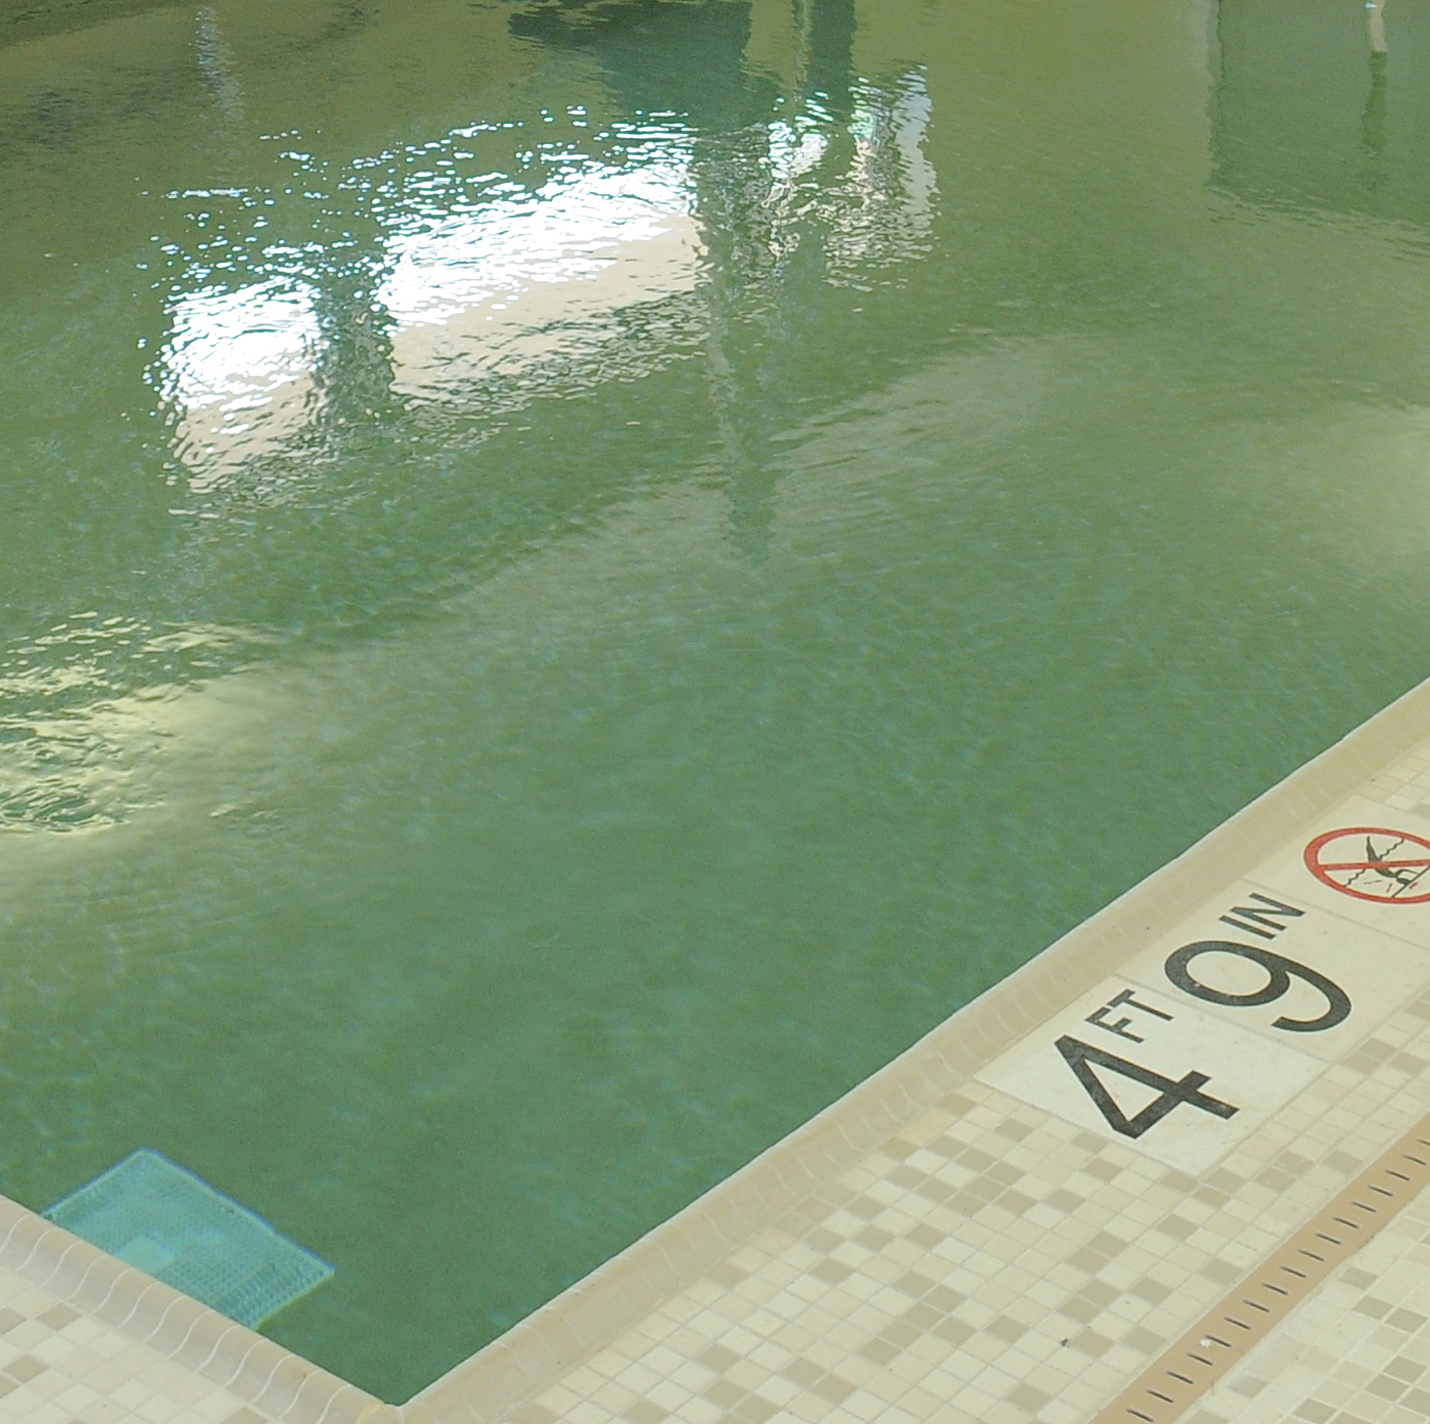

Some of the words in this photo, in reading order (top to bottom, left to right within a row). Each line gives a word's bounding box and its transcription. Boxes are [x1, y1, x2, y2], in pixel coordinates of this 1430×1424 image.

[1219, 892, 1306, 940] IN
[1084, 988, 1175, 1044] FT
[1163, 939, 1352, 1033] 9
[1054, 1033, 1240, 1139] 4
